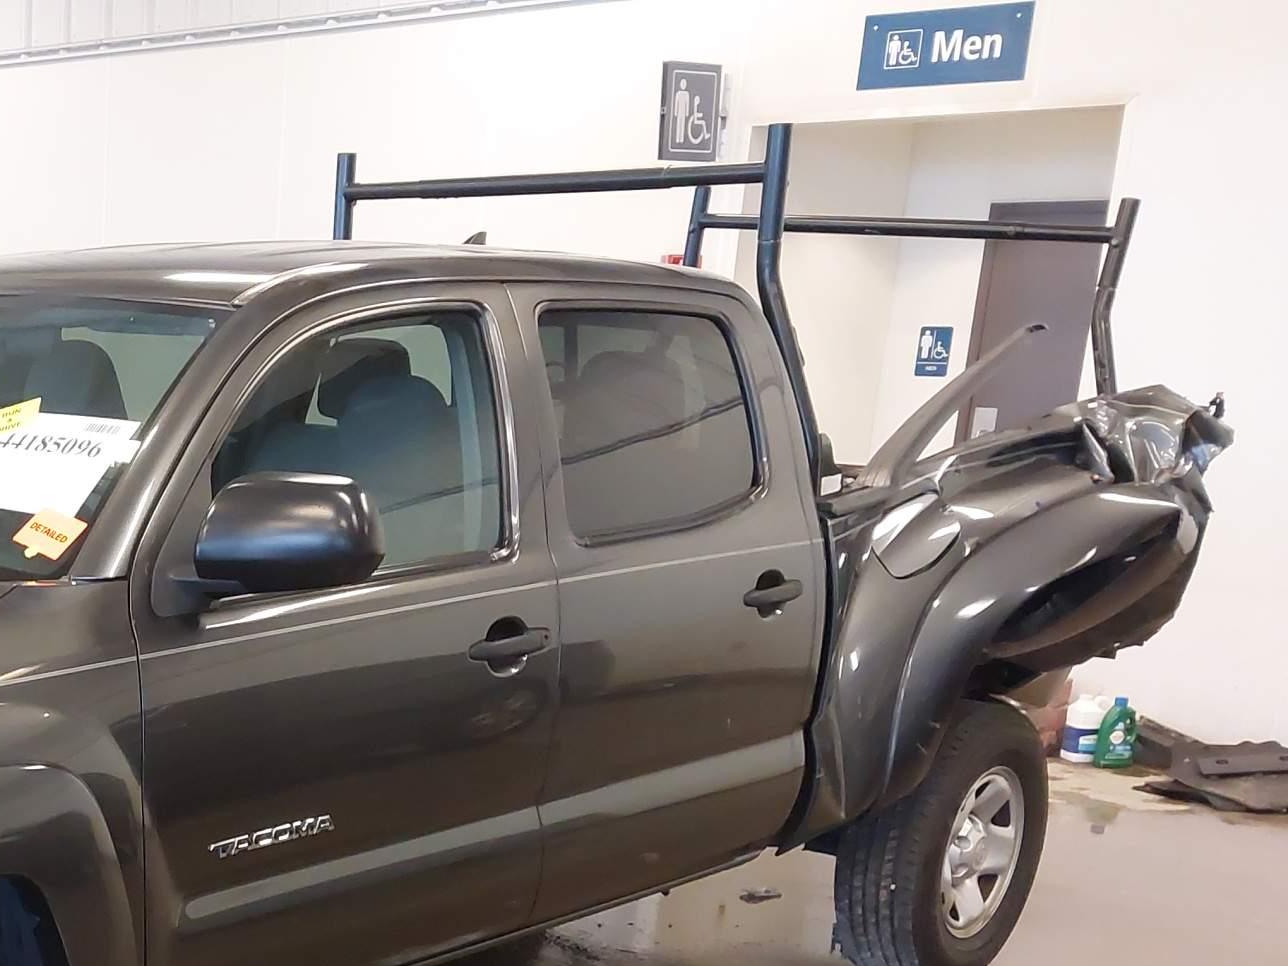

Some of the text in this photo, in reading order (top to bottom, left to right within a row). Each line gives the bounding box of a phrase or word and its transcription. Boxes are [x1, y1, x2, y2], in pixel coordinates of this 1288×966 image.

[930, 29, 1003, 63] Men
[0, 433, 103, 458] 44185096
[30, 521, 68, 543] DETAILED
[207, 814, 335, 859] TACOMA
